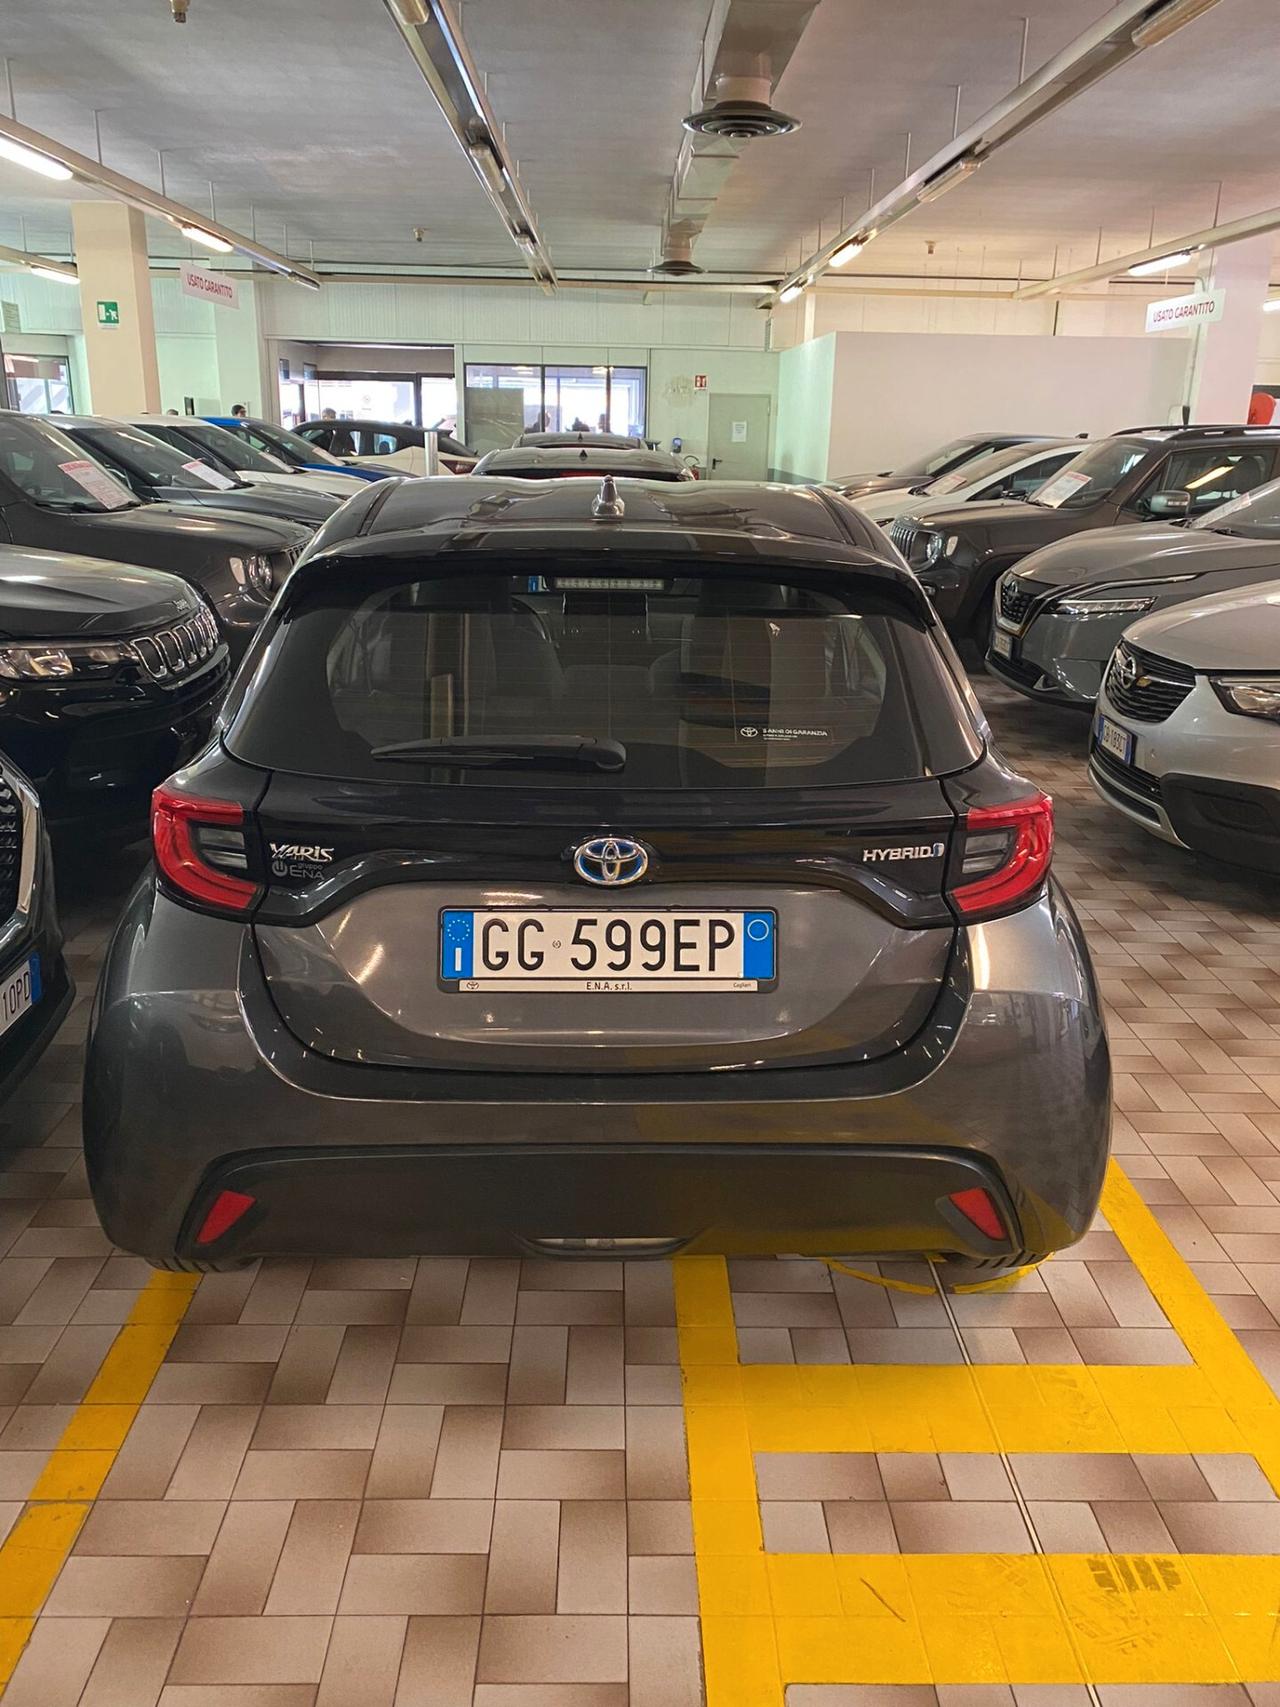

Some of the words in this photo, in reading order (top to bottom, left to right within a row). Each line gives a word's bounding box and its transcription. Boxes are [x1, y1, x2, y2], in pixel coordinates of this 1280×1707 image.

[186, 273, 204, 289] USATO
[1153, 308, 1174, 322] USATO
[1175, 300, 1215, 319] GARANTITO
[269, 843, 335, 863] YARIS
[863, 846, 933, 862] HYBRID
[289, 865, 326, 880] ENA
[482, 918, 544, 971] GG
[571, 918, 735, 972] 599EP
[586, 981, 613, 991] E.N.A.
[614, 981, 633, 991] s.r.l.
